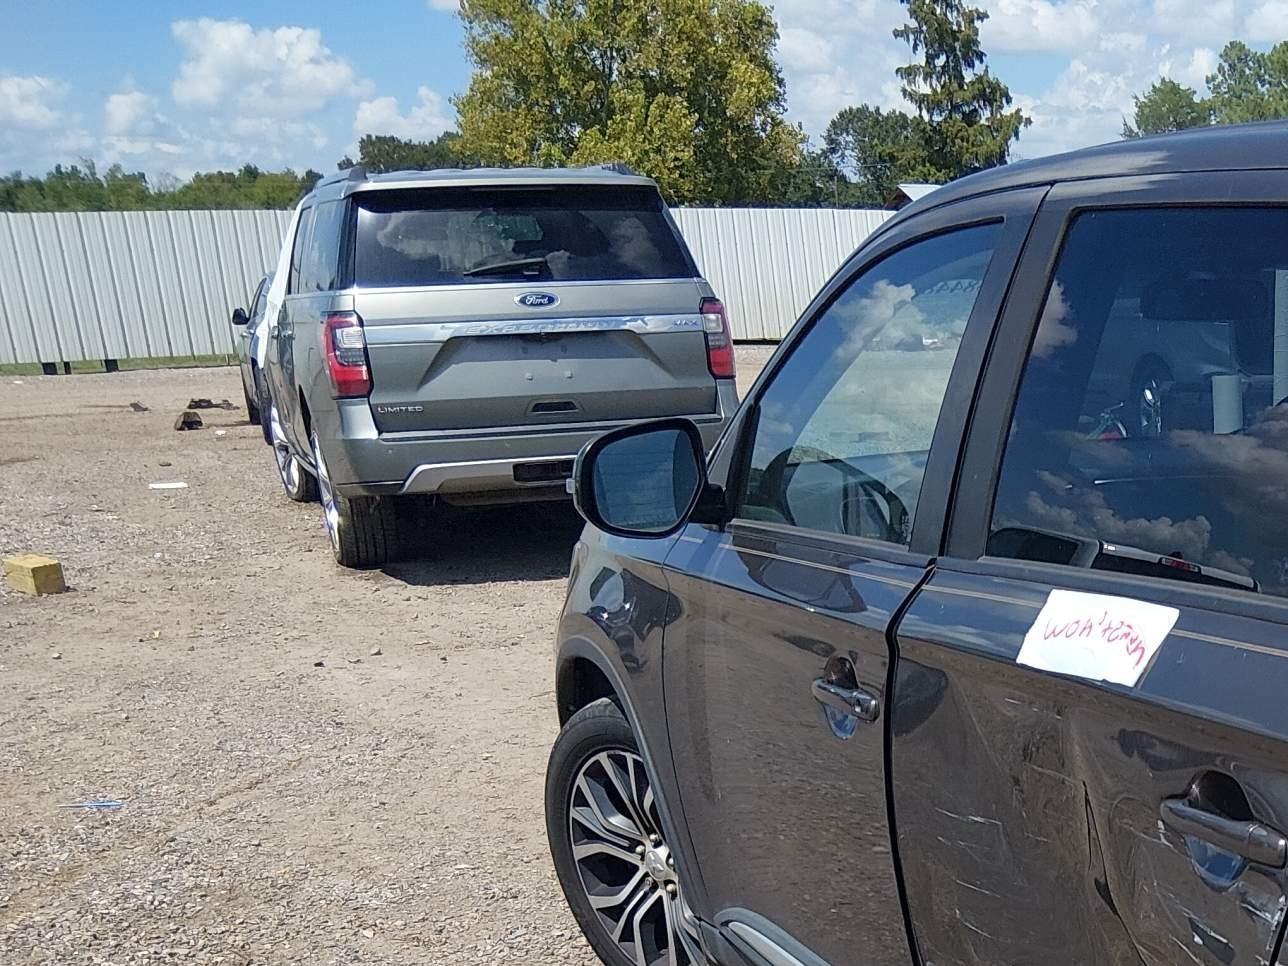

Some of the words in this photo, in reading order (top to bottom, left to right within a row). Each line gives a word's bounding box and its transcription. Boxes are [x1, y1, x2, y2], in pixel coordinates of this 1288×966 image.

[525, 294, 549, 305] Ford
[671, 318, 698, 327] MAX
[377, 405, 424, 414] LIMITED
